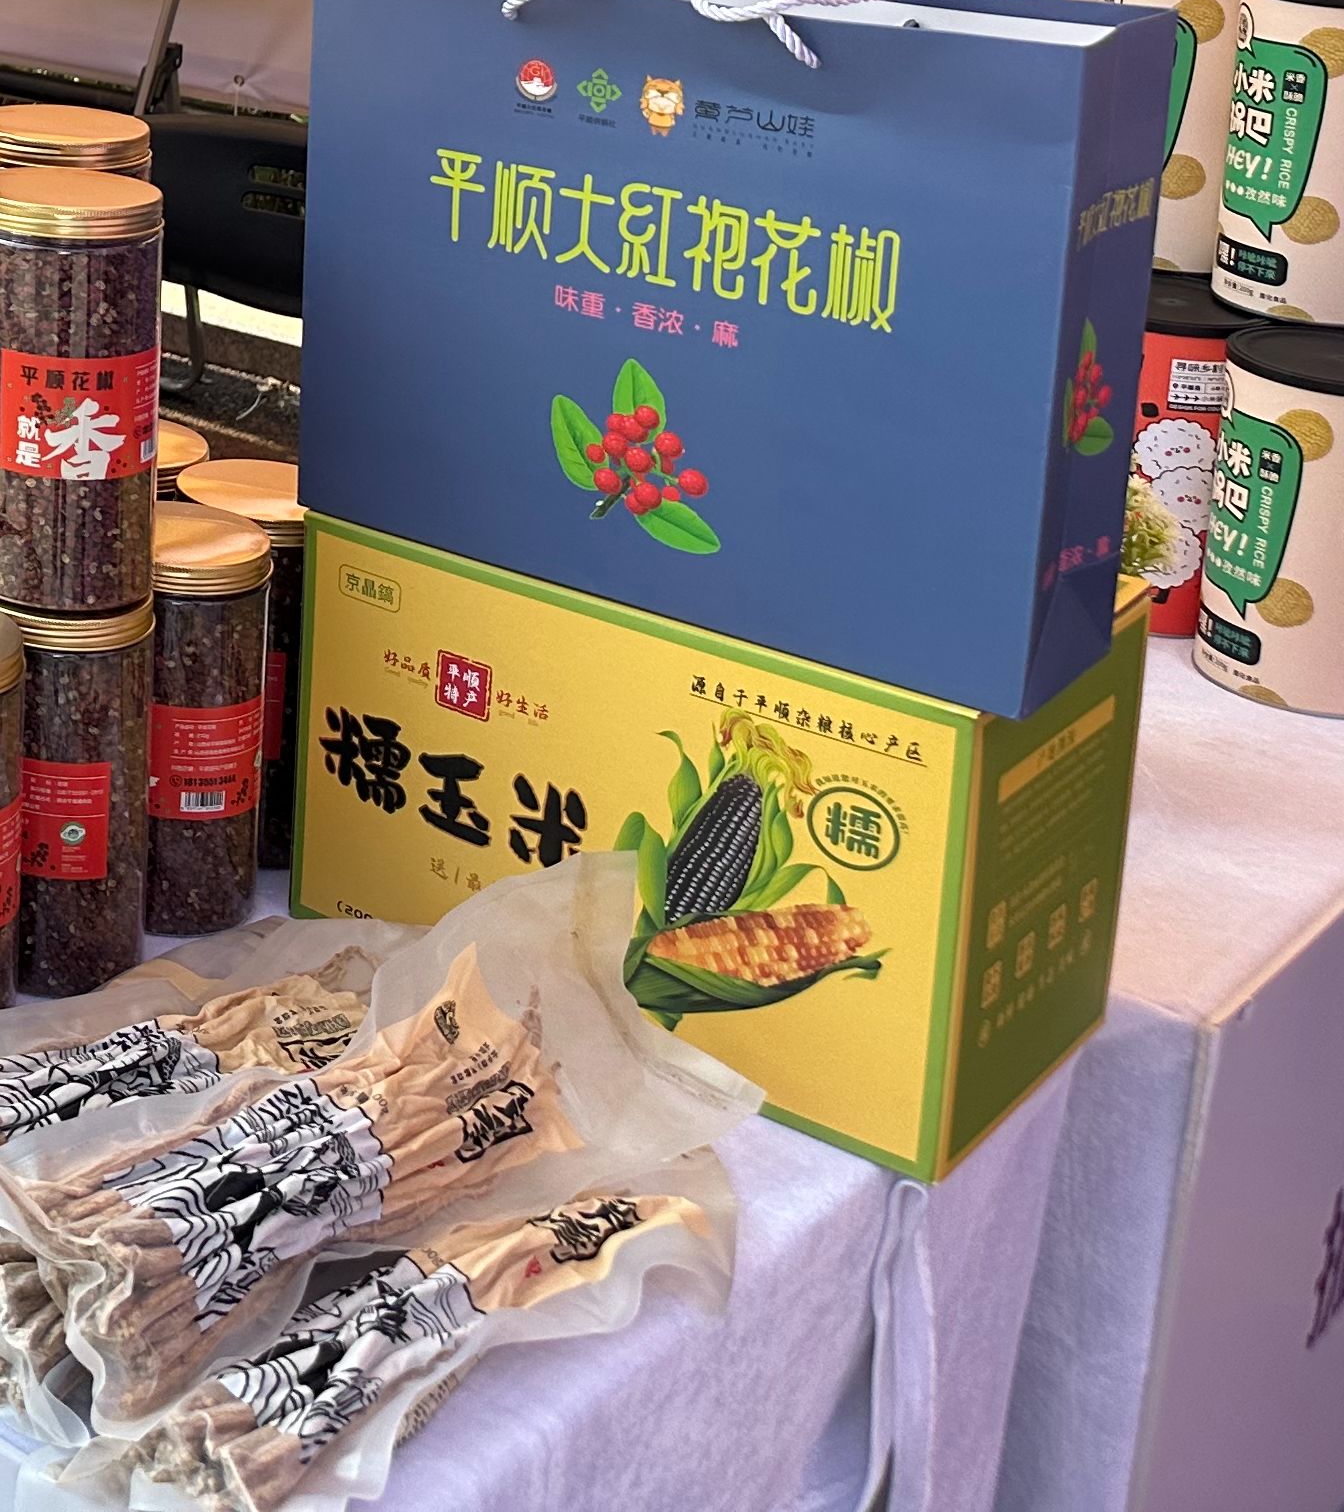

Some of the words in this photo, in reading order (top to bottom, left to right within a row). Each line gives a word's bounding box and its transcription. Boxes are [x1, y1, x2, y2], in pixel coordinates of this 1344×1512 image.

[1282, 107, 1299, 156] CRISPY
[1277, 158, 1293, 190] RICE
[41, 397, 127, 481] 香
[1256, 484, 1274, 535] CRISPY
[1251, 536, 1268, 570] RICE
[383, 648, 432, 680] 好品质
[495, 688, 551, 722] 好生活
[690, 674, 924, 763] 源自于平顺杂粮核心产区
[318, 705, 589, 869] 糯玉米
[824, 800, 883, 860] 糯
